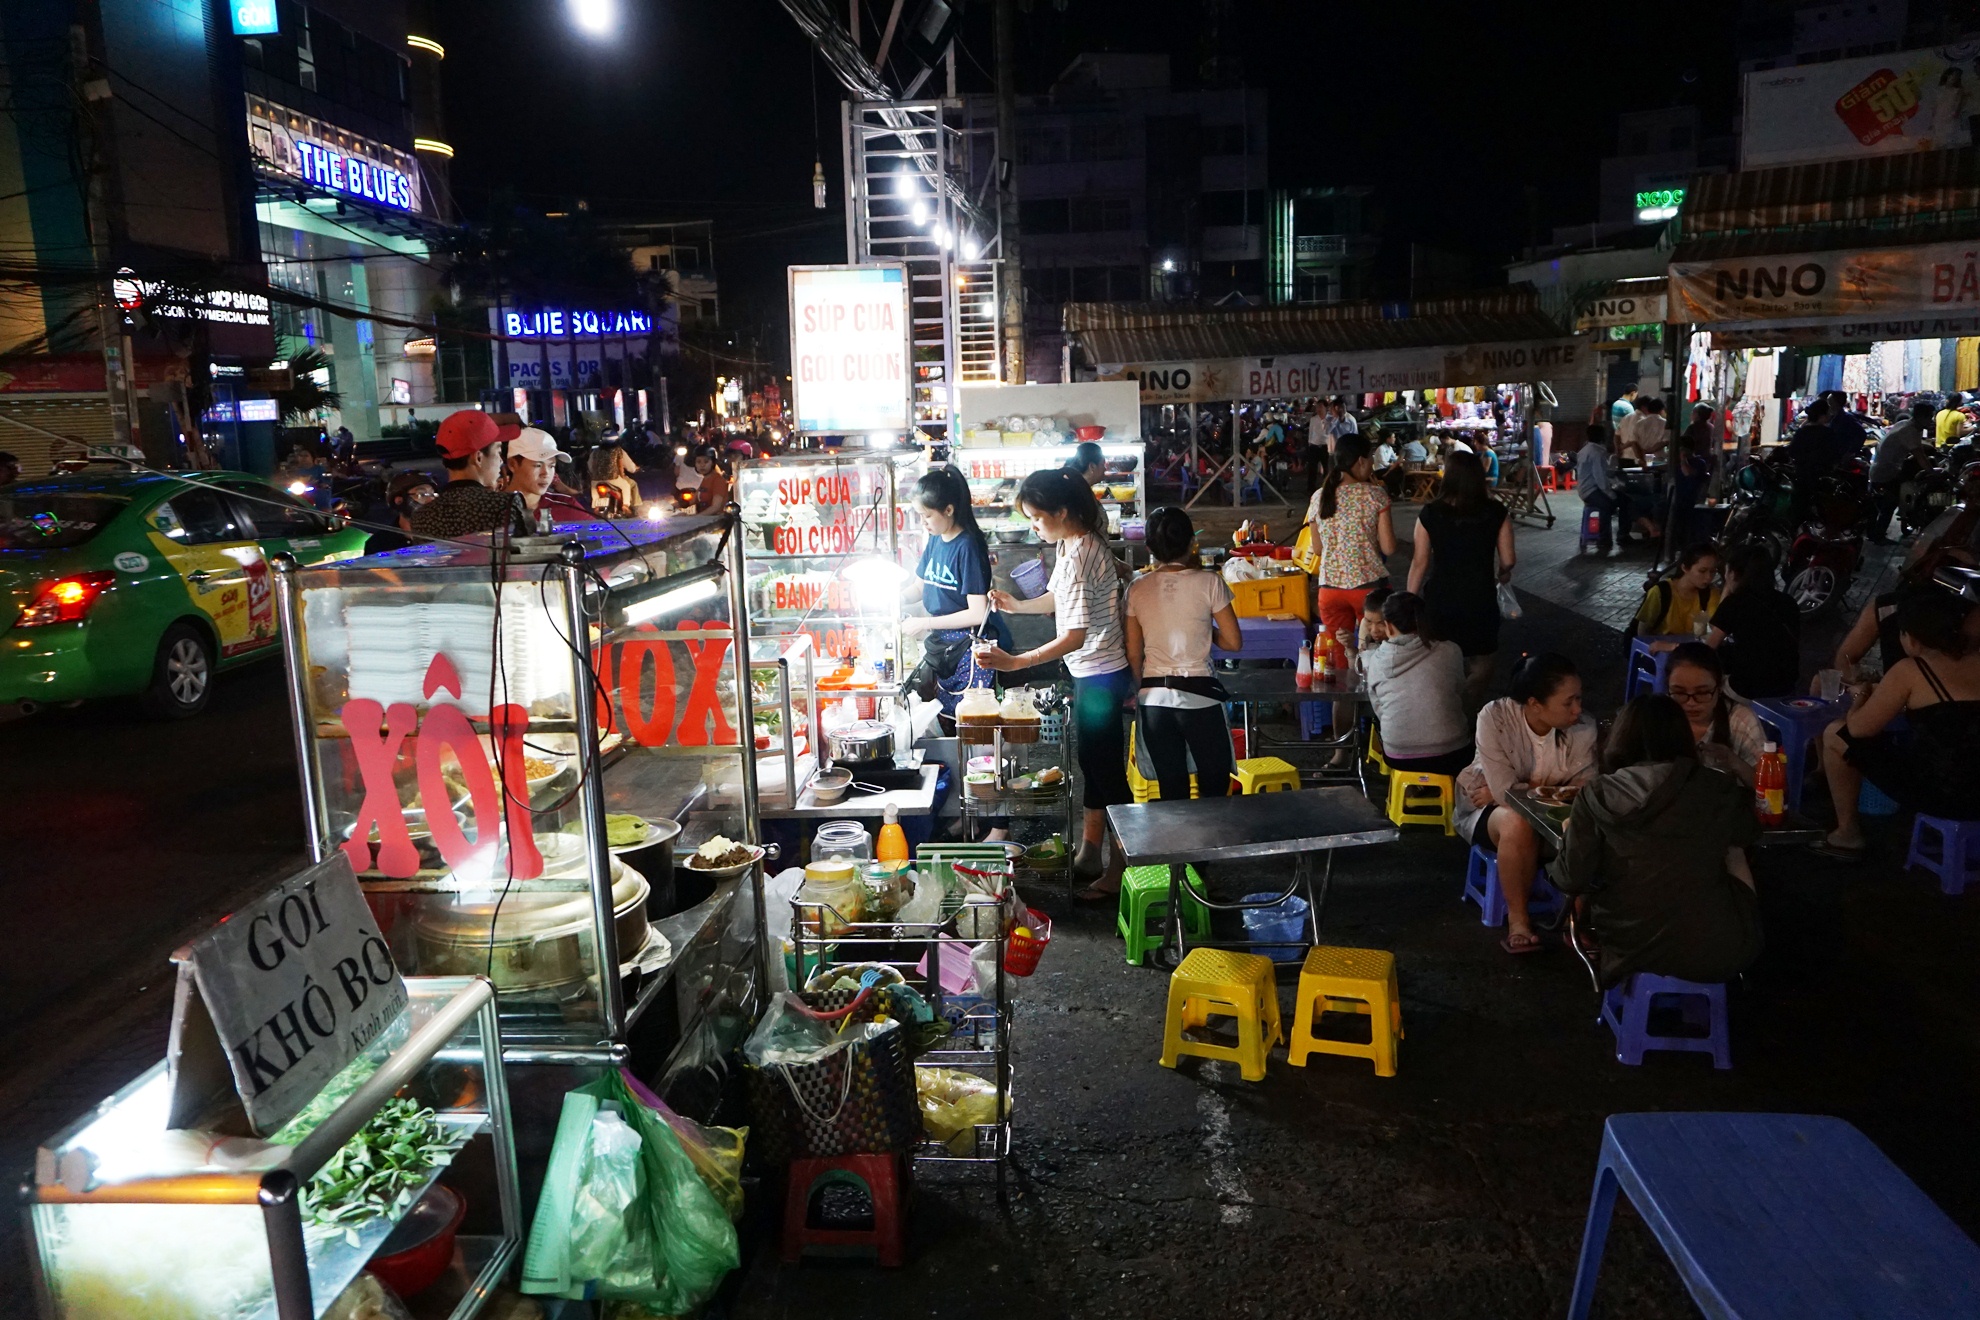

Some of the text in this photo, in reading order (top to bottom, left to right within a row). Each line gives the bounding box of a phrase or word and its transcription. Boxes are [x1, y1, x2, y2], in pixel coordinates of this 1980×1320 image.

[297, 141, 411, 209] THE BLUES
[1715, 263, 1826, 301] NNO
[247, 313, 270, 325] BANK
[506, 312, 564, 336] BLUE
[853, 303, 895, 332] CUA
[1482, 345, 1575, 370] NNO VITE
[1326, 366, 1351, 391] XE
[816, 476, 851, 506] CUA
[776, 575, 822, 610] BÁNH
[340, 652, 543, 880] XÔI
[234, 928, 395, 1098] KHÔ BÒ
